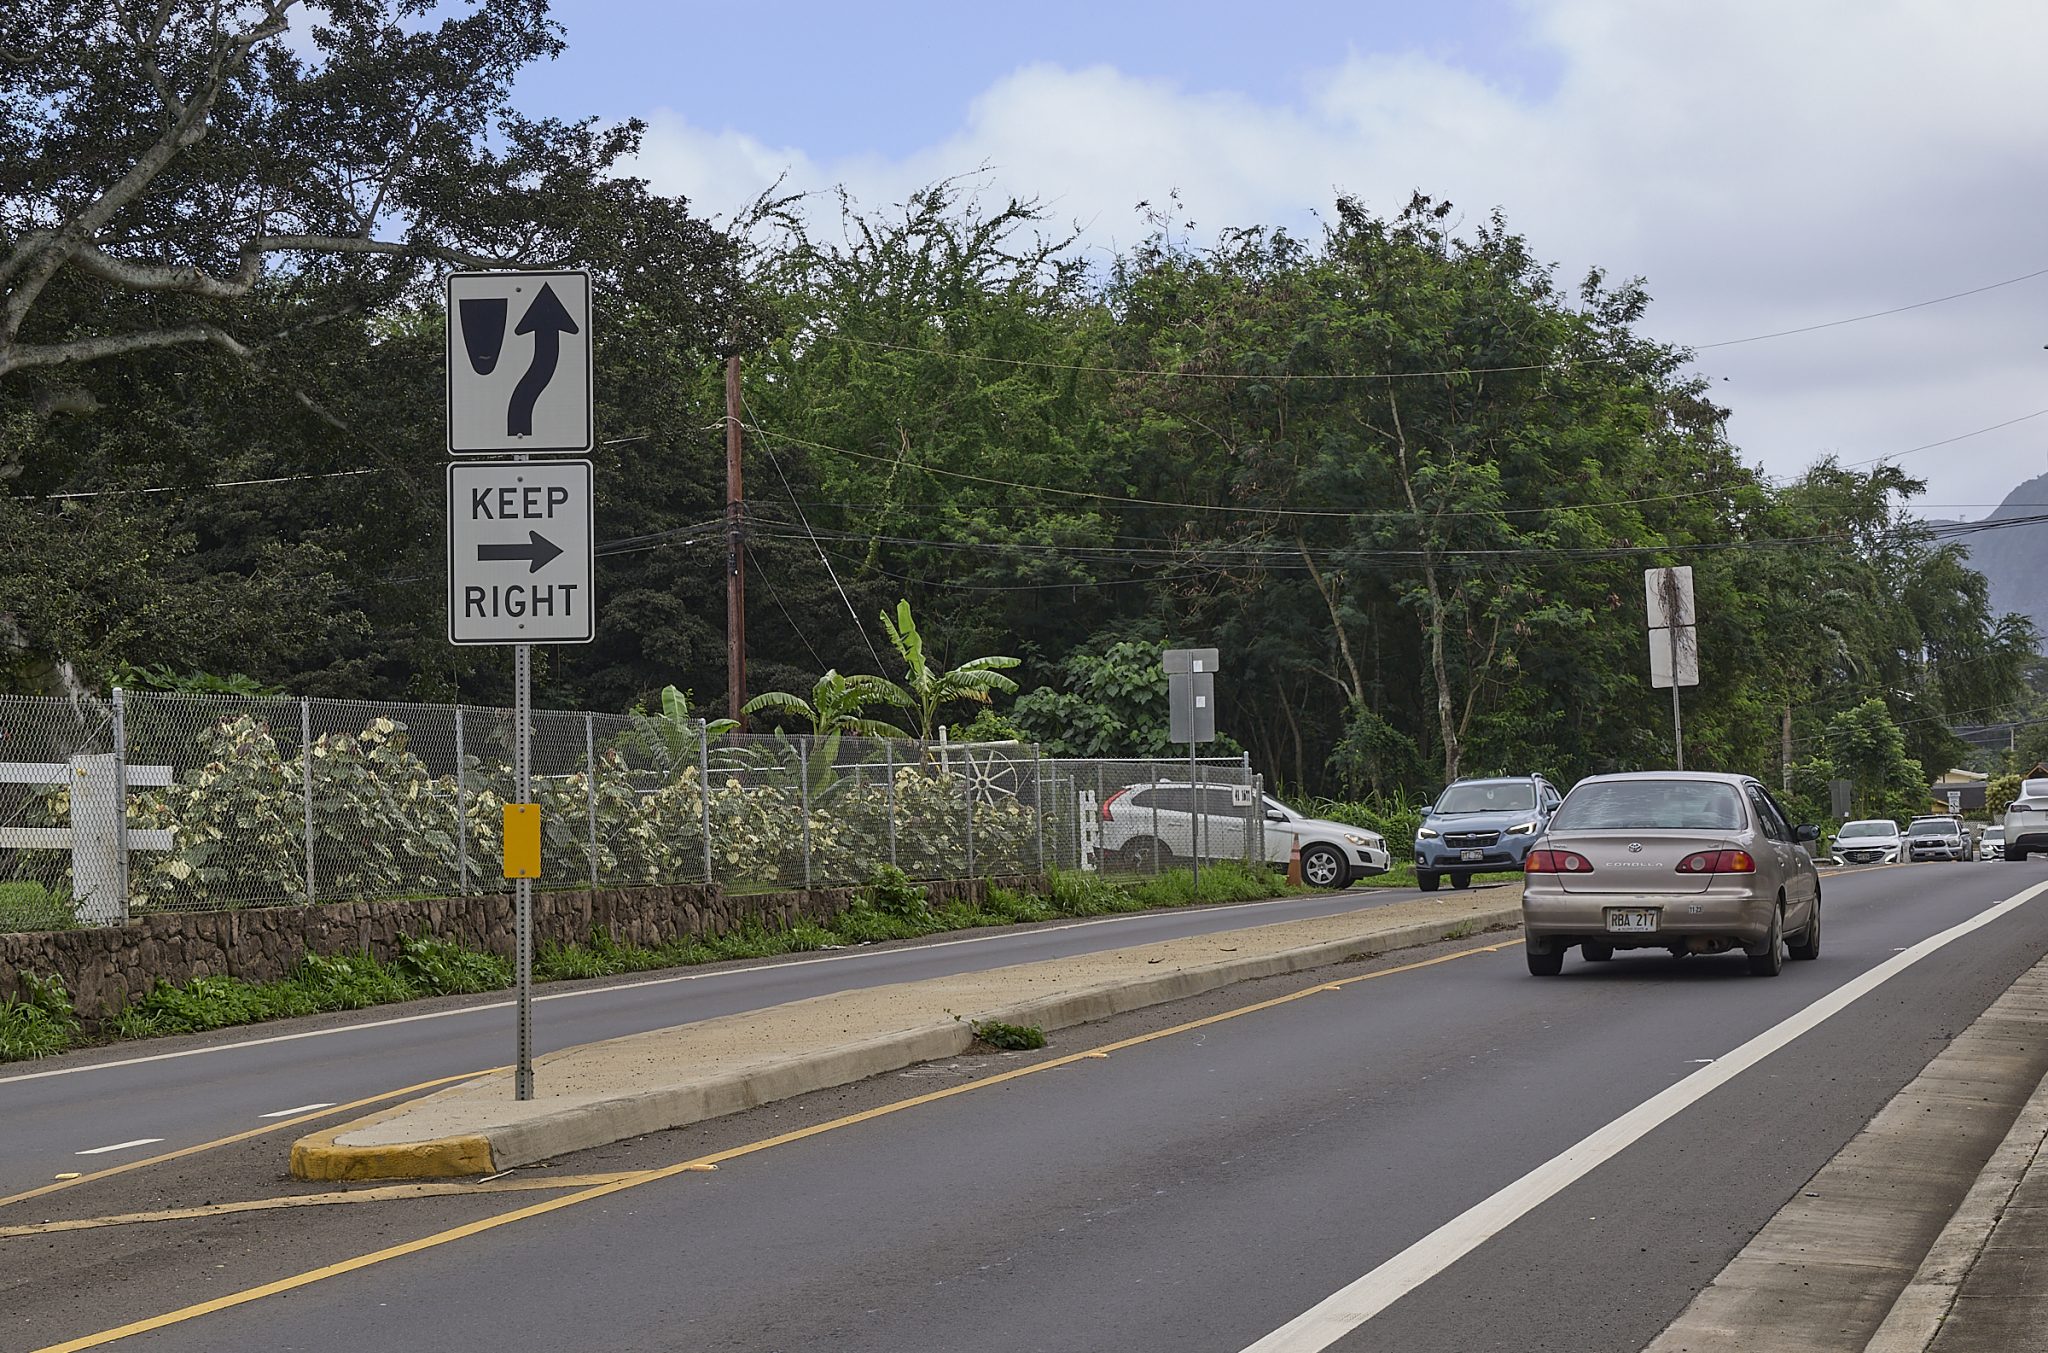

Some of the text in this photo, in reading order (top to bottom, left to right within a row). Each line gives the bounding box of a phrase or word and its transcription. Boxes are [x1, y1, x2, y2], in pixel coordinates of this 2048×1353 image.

[472, 487, 569, 520] KEEP
[465, 584, 578, 618] RIGHT
[1611, 913, 1656, 927] RBA 217
